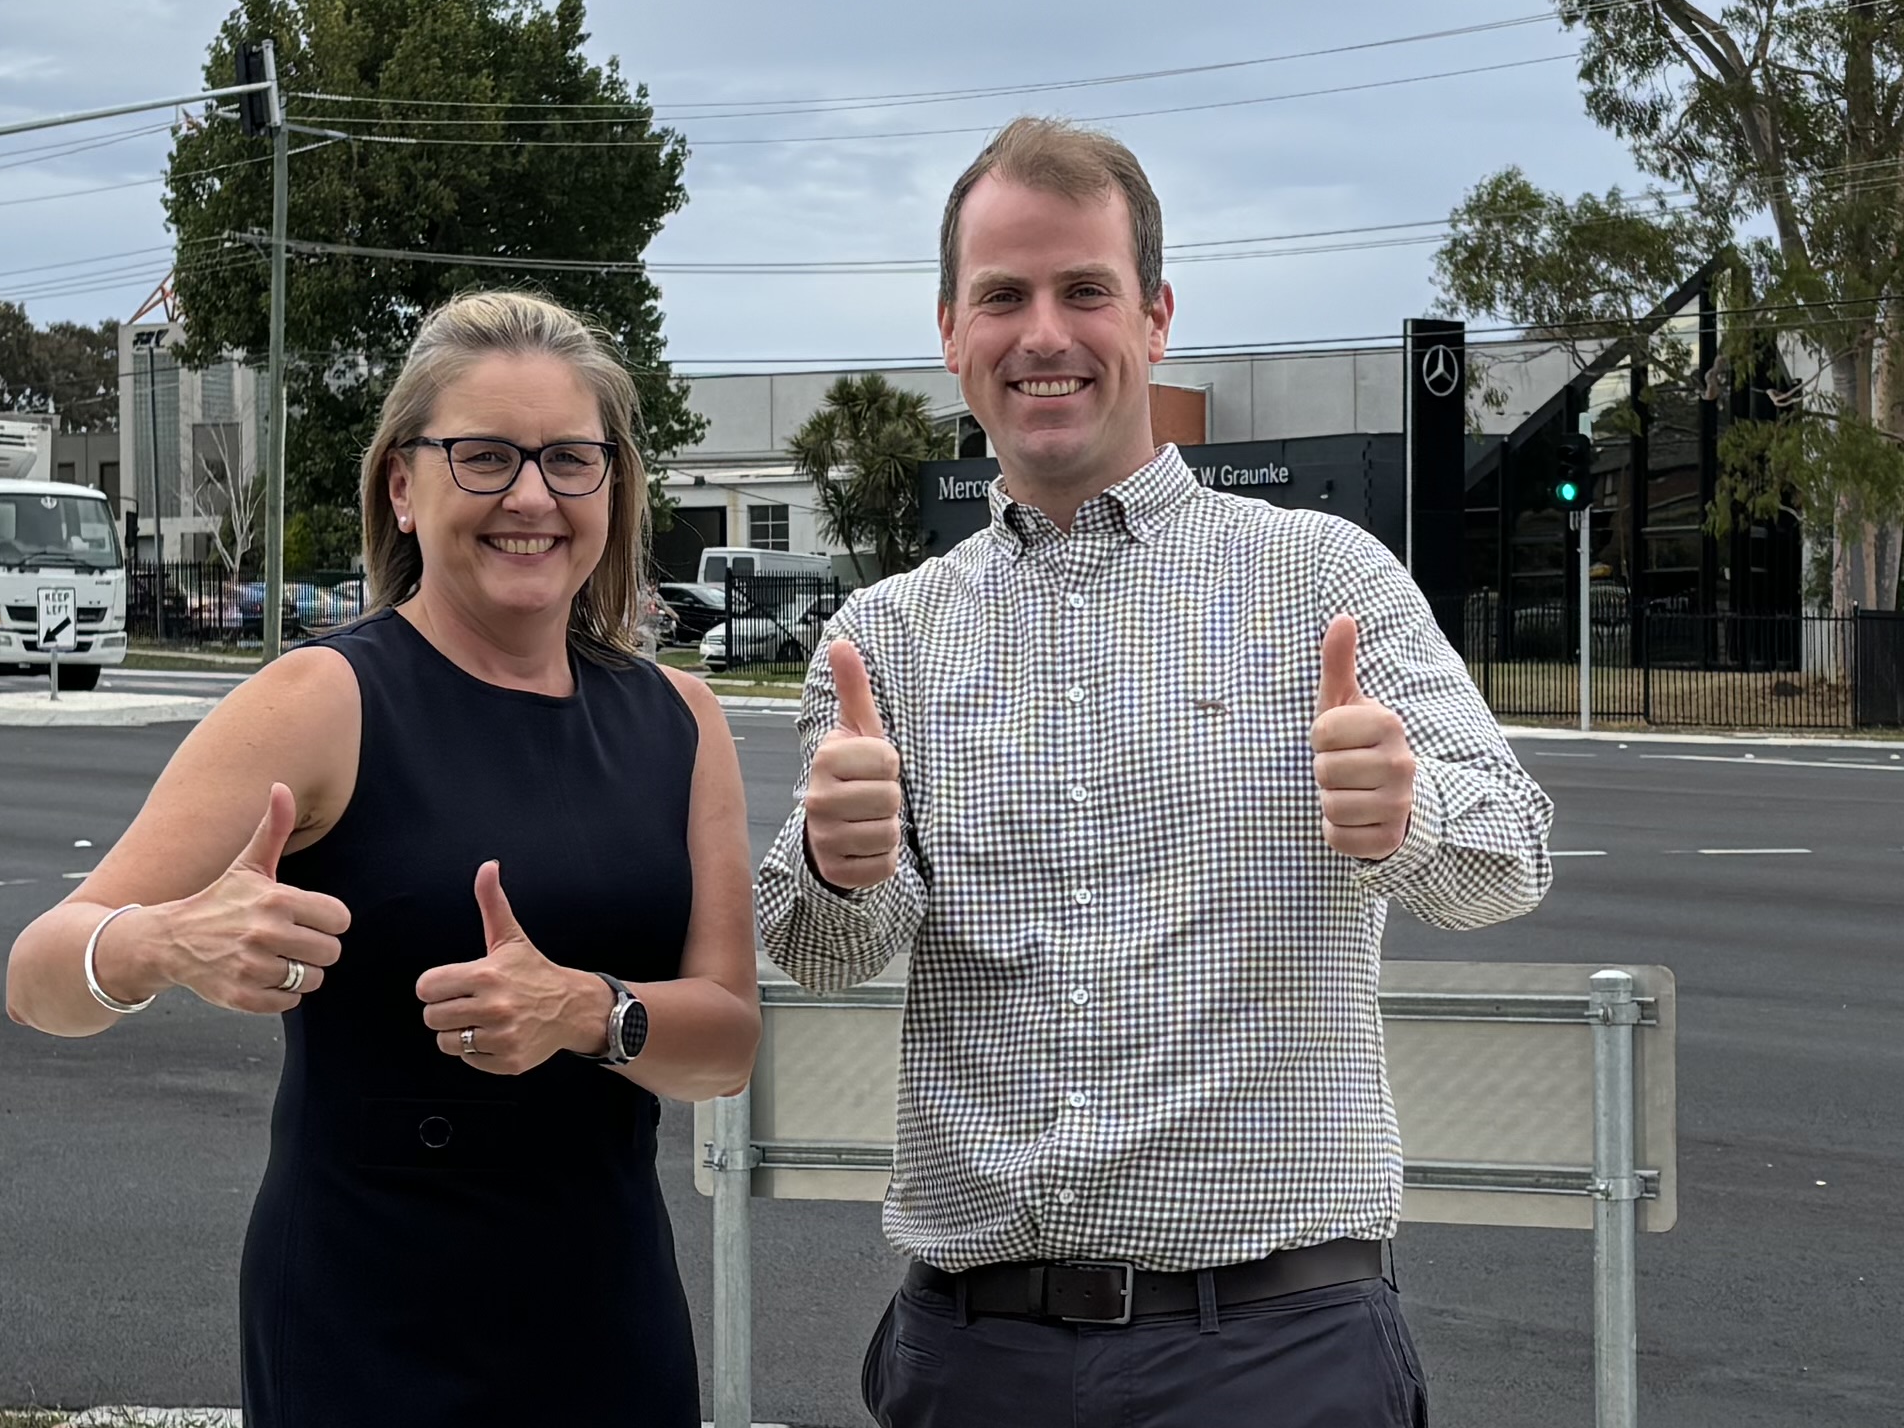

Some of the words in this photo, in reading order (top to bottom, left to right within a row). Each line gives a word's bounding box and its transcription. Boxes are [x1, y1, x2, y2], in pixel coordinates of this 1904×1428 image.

[1200, 466, 1216, 486] W
[1220, 462, 1289, 487] Graunke
[44, 593, 70, 602] KEEP
[46, 604, 68, 615] LEFT
